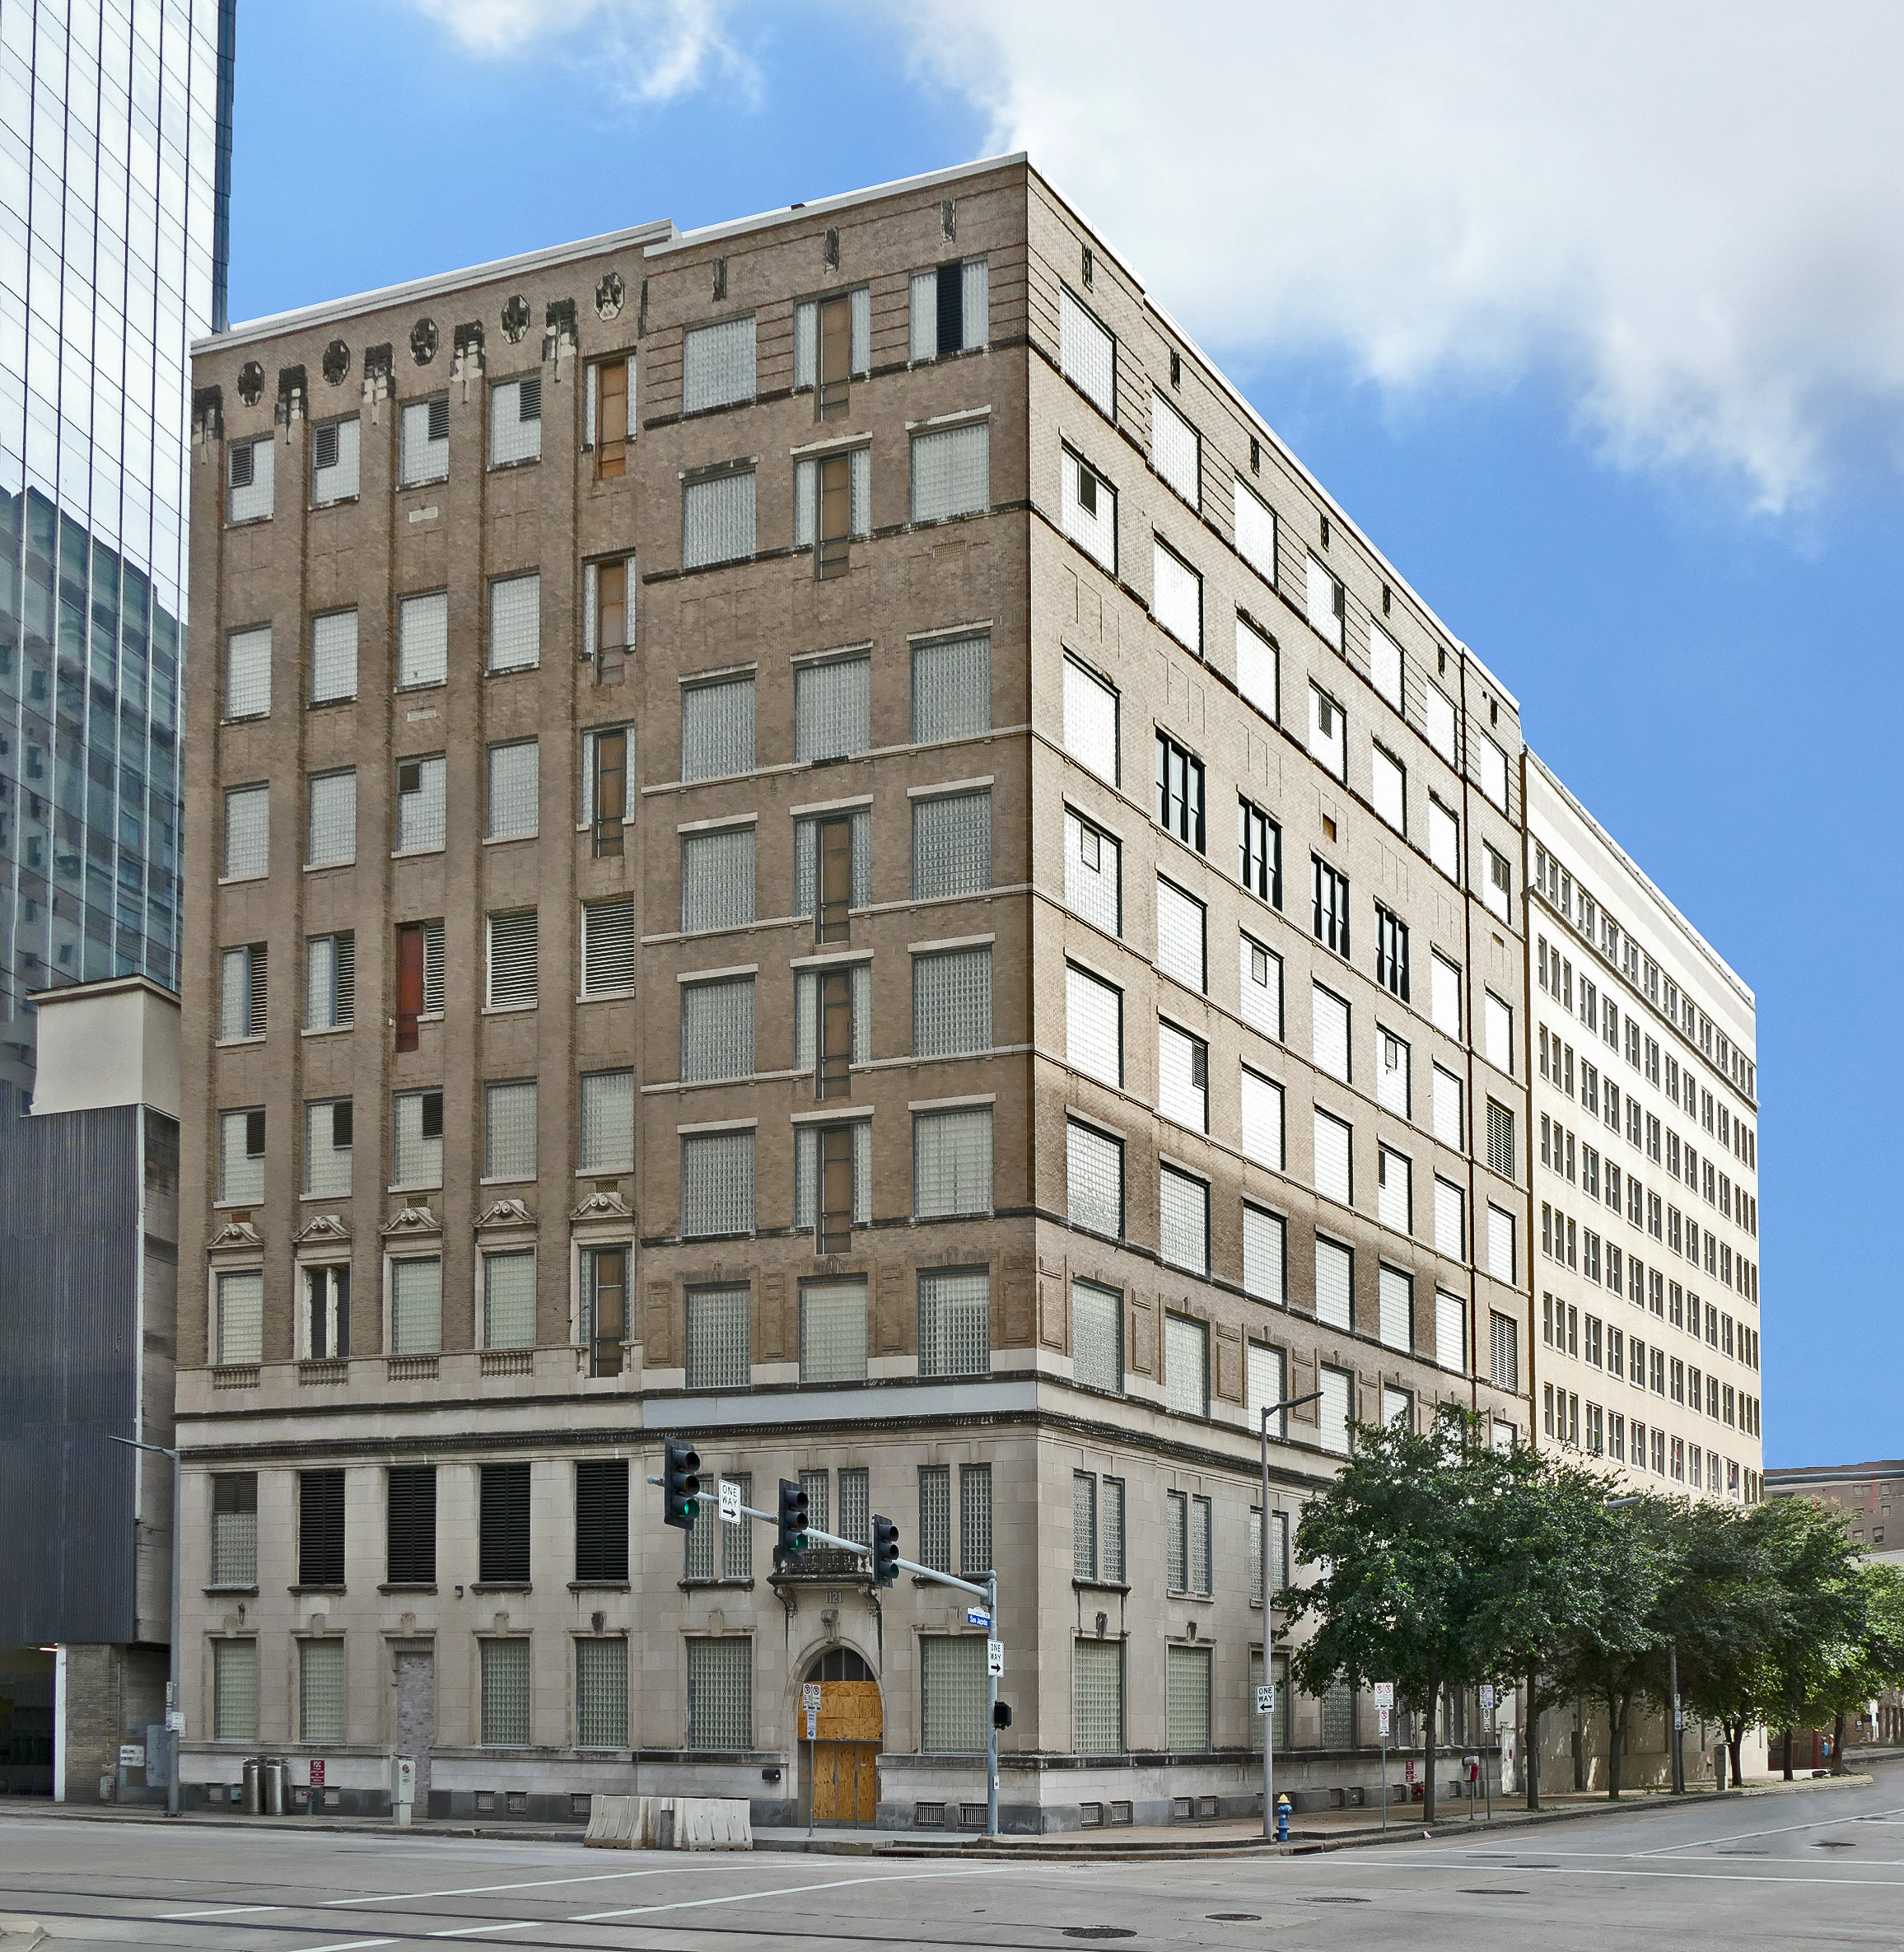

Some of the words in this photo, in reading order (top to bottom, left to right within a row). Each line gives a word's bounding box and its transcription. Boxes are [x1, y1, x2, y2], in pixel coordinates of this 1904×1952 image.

[722, 1484, 737, 1497] ONE
[722, 1495, 737, 1507] WAY
[824, 1591, 842, 1603] 1121
[977, 1617, 988, 1627] Jacinto
[990, 1643, 1001, 1652] ONE
[990, 1652, 1001, 1661] WAY
[1258, 1687, 1272, 1695] ONE
